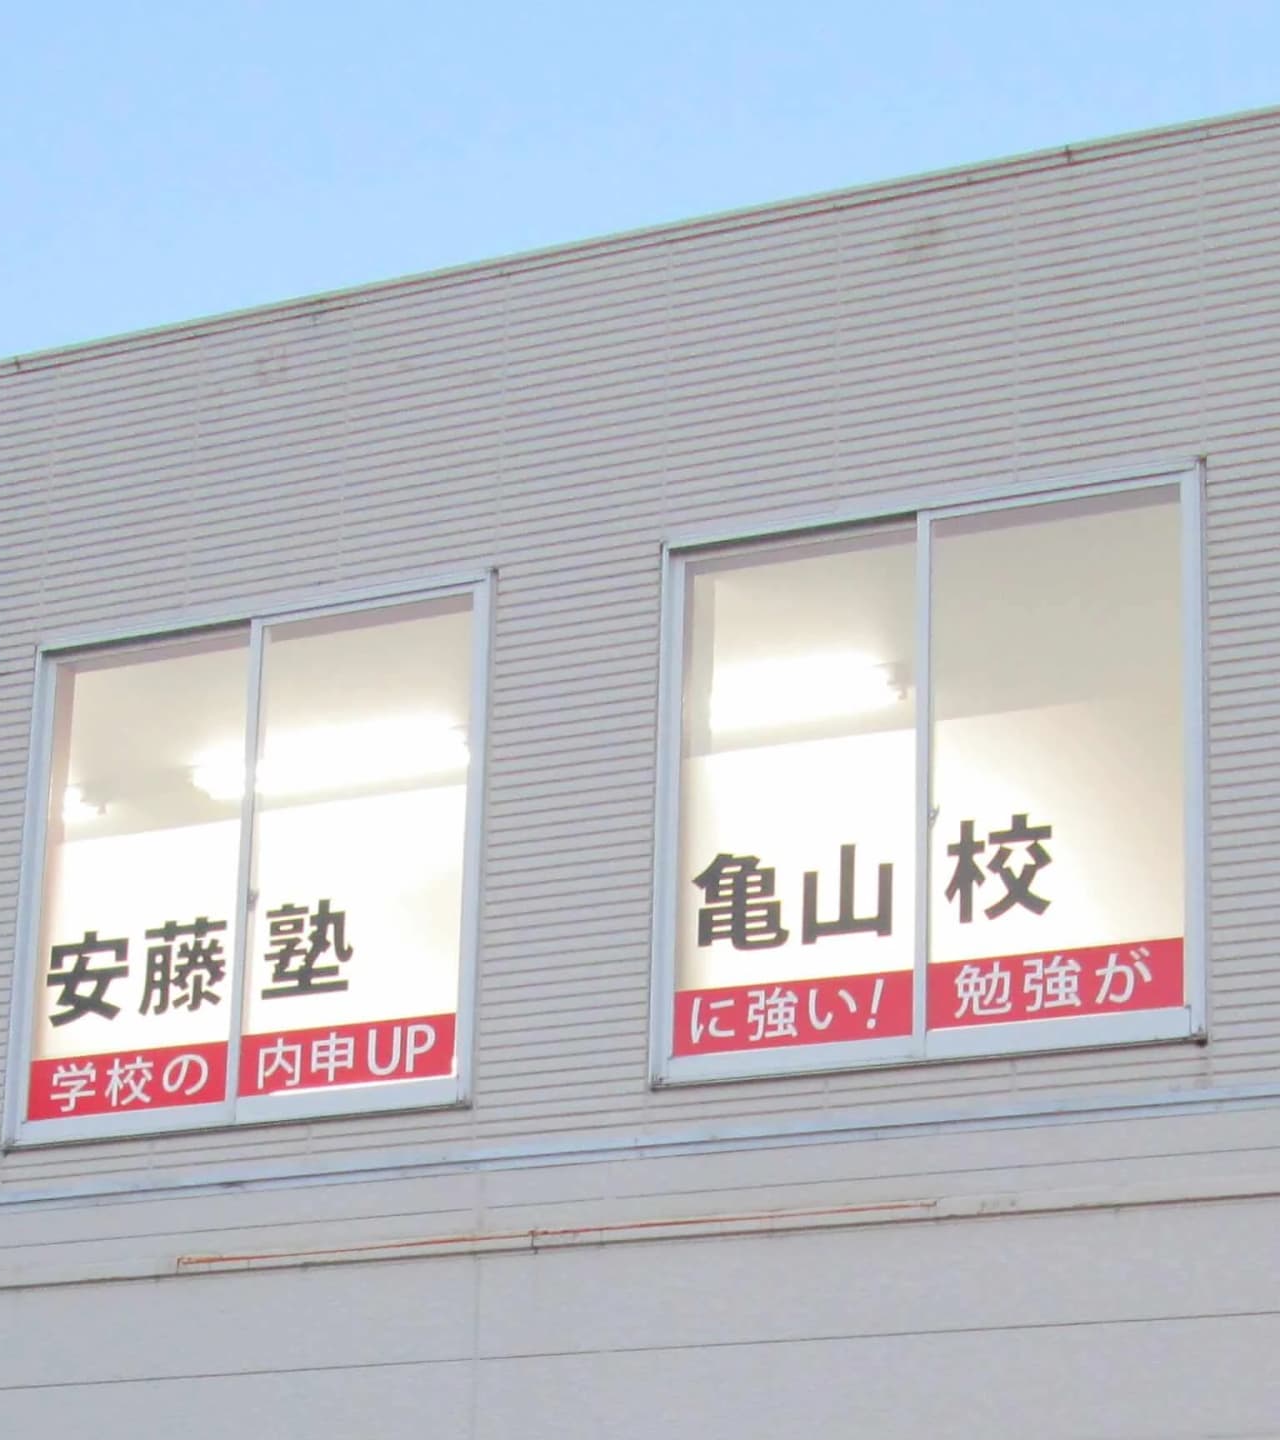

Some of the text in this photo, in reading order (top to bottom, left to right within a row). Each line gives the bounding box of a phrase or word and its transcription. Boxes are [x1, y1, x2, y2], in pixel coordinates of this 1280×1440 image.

[691, 813, 1054, 951] 亀山校
[46, 898, 354, 1027] 安藤塾
[953, 948, 1152, 1019] 勉強が
[49, 1023, 435, 1113] 学校の 内申UP
